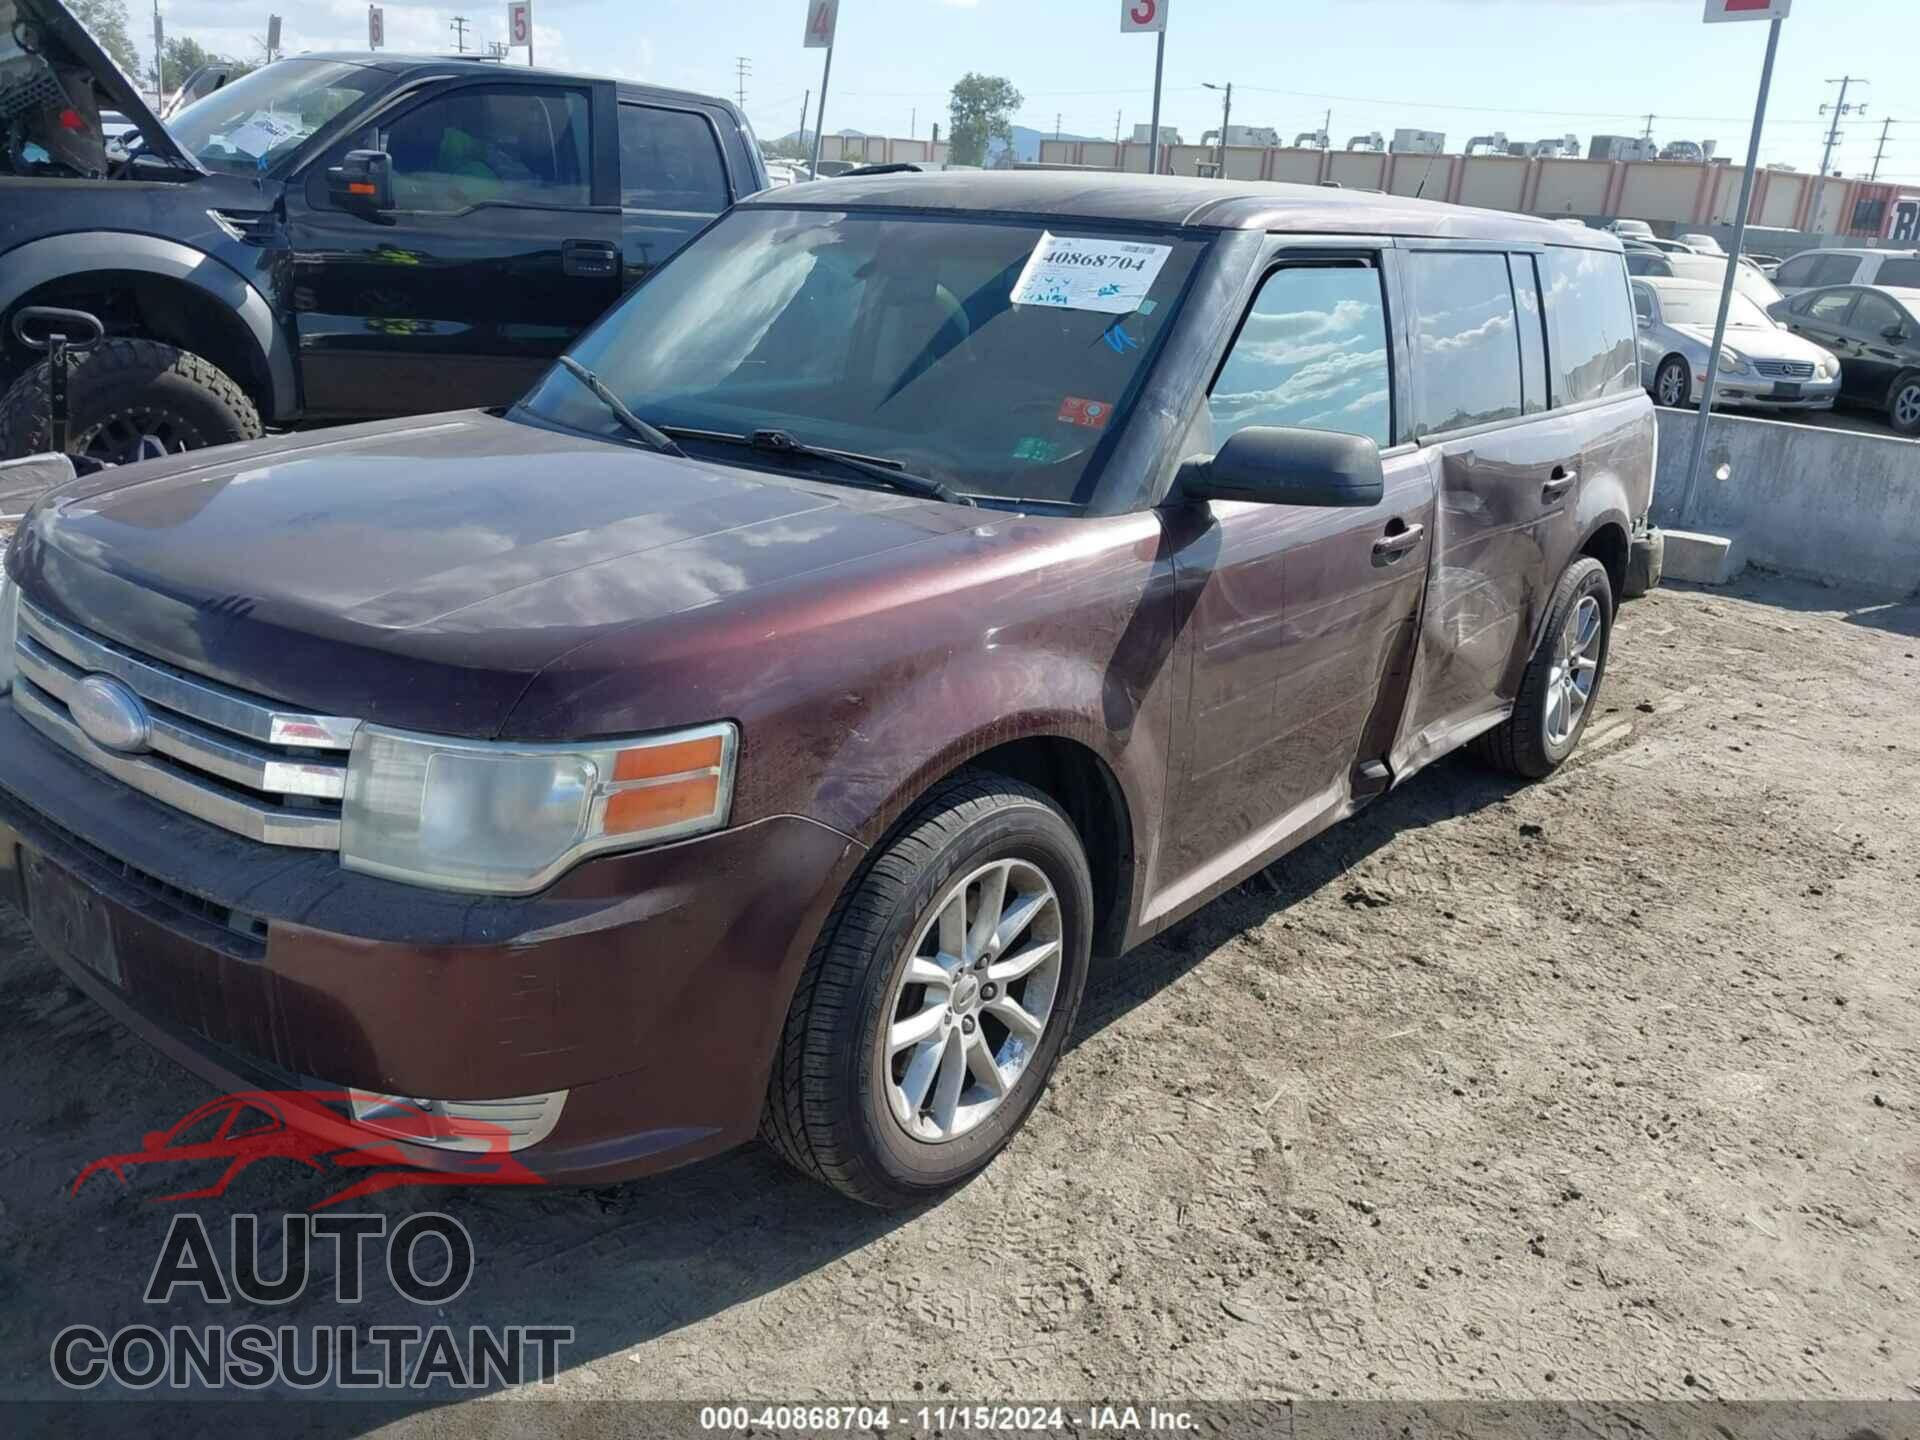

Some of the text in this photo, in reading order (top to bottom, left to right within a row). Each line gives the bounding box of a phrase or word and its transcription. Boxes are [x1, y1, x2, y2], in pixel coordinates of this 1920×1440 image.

[371, 14, 380, 41] 6
[514, 8, 526, 41] 5
[812, 1, 832, 41] 4
[1043, 250, 1146, 272] 40868704
